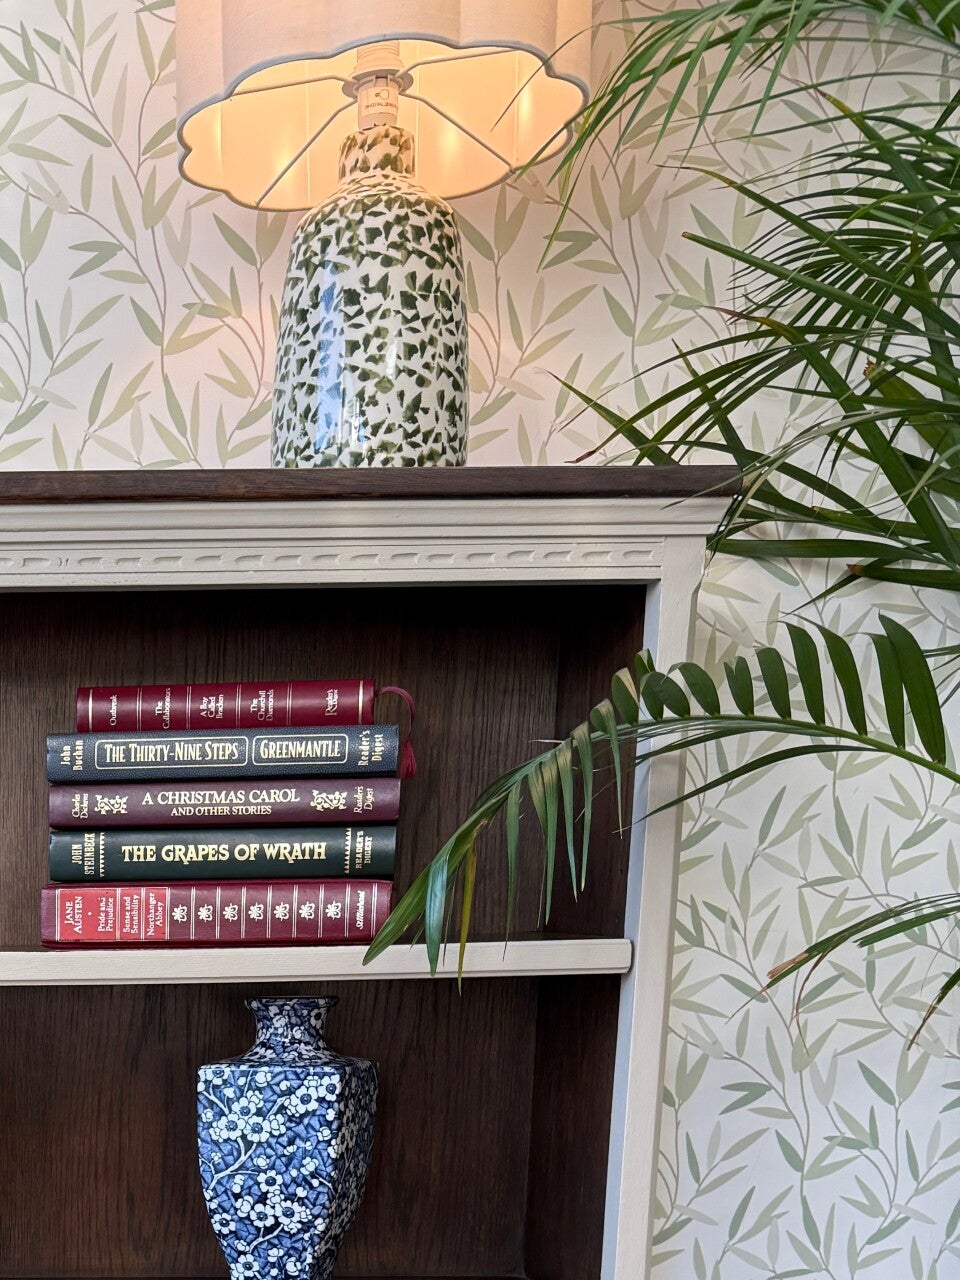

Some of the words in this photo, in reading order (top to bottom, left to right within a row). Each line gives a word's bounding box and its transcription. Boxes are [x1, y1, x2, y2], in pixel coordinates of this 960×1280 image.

[109, 694, 118, 726] Outbreak
[155, 701, 163, 715] The
[199, 697, 208, 707] Boy
[207, 697, 216, 717] Called
[250, 698, 258, 713] The
[257, 690, 266, 720] Churchill
[265, 689, 274, 721] Diamonds
[60, 746, 71, 765] John
[72, 740, 84, 771] Buchan
[105, 743, 126, 763] THE
[128, 741, 202, 762] THIRTY-NINE
[205, 740, 239, 760] STEPS
[259, 739, 341, 759] GREENMANTLE
[357, 730, 371, 767] Reader's
[371, 733, 384, 761] Digest
[71, 793, 81, 818] Charles
[79, 793, 89, 819] Dickens
[142, 791, 155, 806] A
[157, 789, 245, 805] CHRISTMAS
[248, 788, 301, 804] CAROL
[353, 785, 364, 814] Reader's
[363, 787, 375, 811] Digest
[170, 807, 194, 817] AND
[195, 806, 230, 816] OTHER
[231, 804, 272, 816] STORIES
[71, 843, 83, 865] JOHN
[84, 832, 95, 876] STEINBECK
[121, 845, 157, 862] THE
[161, 844, 230, 865] GRAPES
[234, 843, 260, 861] OF
[262, 841, 327, 864] WRATH
[355, 830, 364, 870] READER'S
[363, 835, 373, 864] DIGEST
[64, 901, 74, 925] JANE
[73, 896, 83, 934] AUSTEN
[105, 897, 115, 932] Prejudice
[122, 896, 131, 911] and
[130, 894, 141, 934] Sensibility
[146, 892, 157, 936] Northanger
[154, 901, 165, 927] Abbey
[97, 912, 106, 932] Pride
[123, 912, 131, 933] Sense
